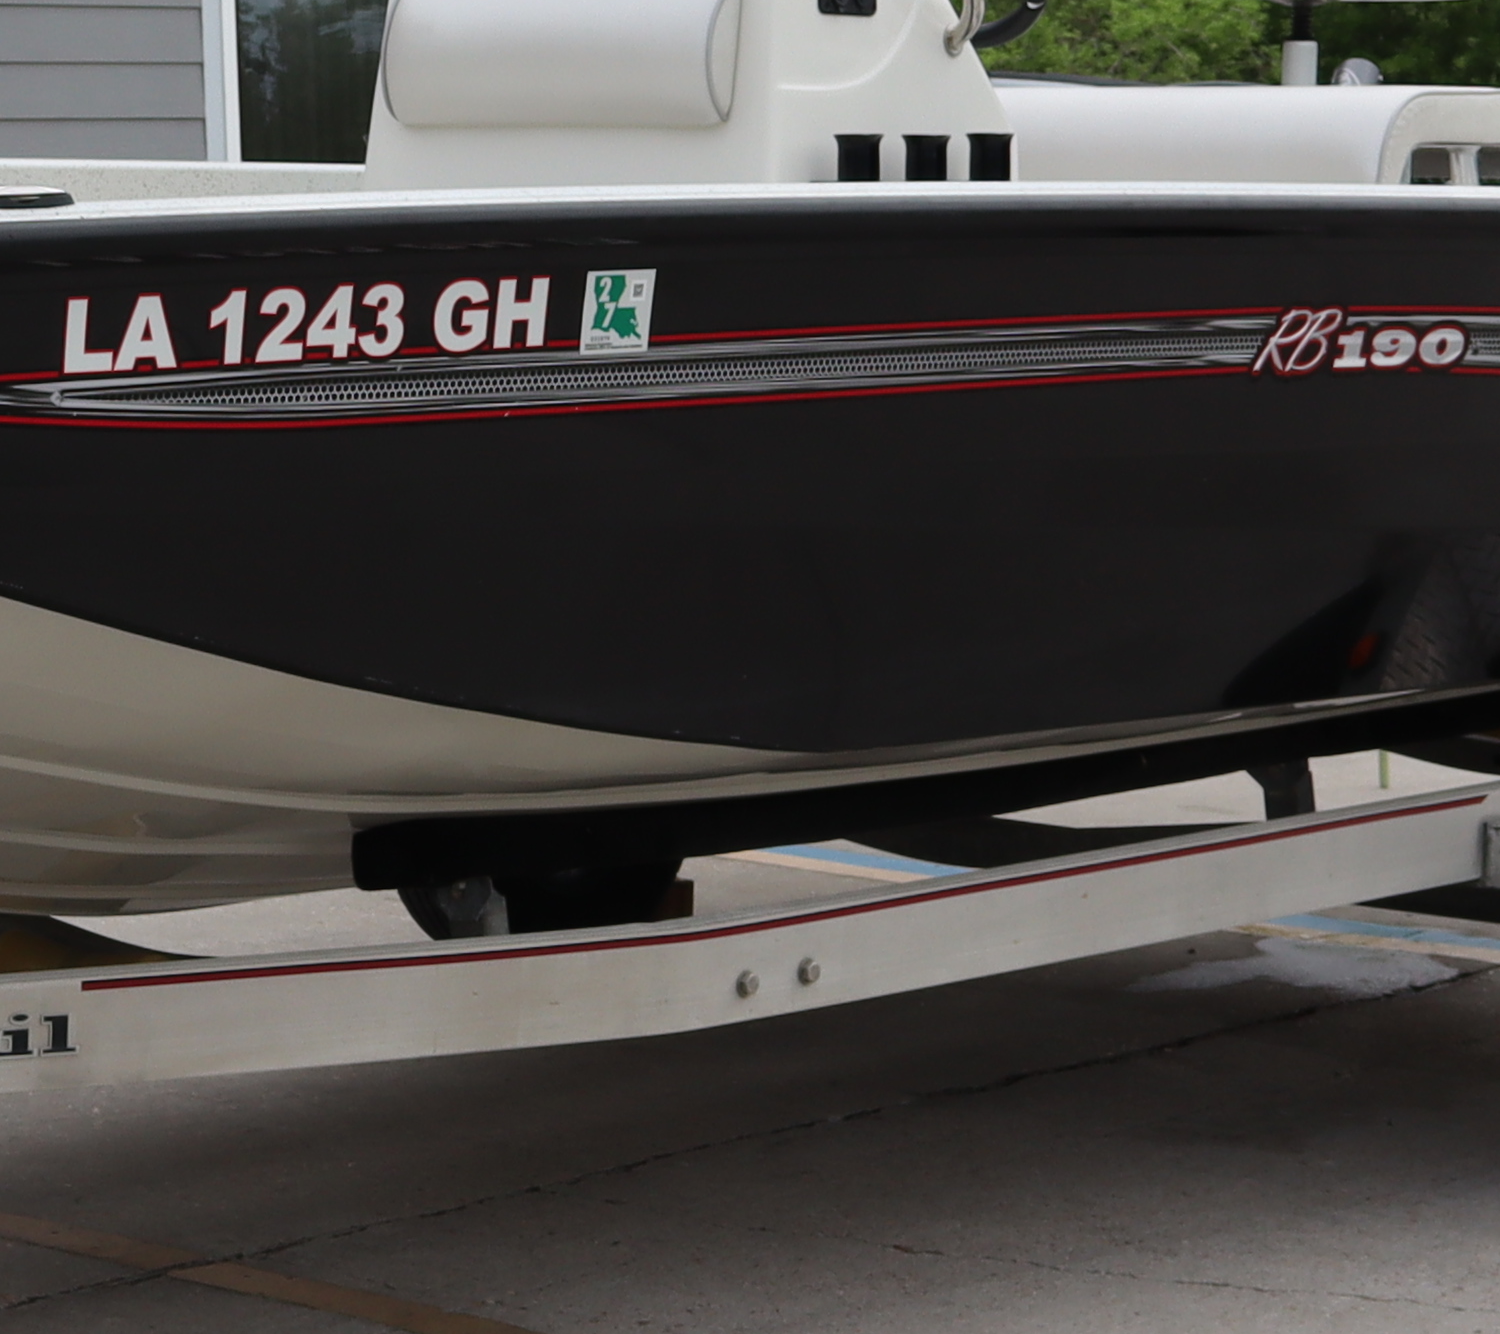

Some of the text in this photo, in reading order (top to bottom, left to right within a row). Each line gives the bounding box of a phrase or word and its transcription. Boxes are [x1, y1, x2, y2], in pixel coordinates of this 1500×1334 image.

[63, 276, 551, 374] LA 1243 GH
